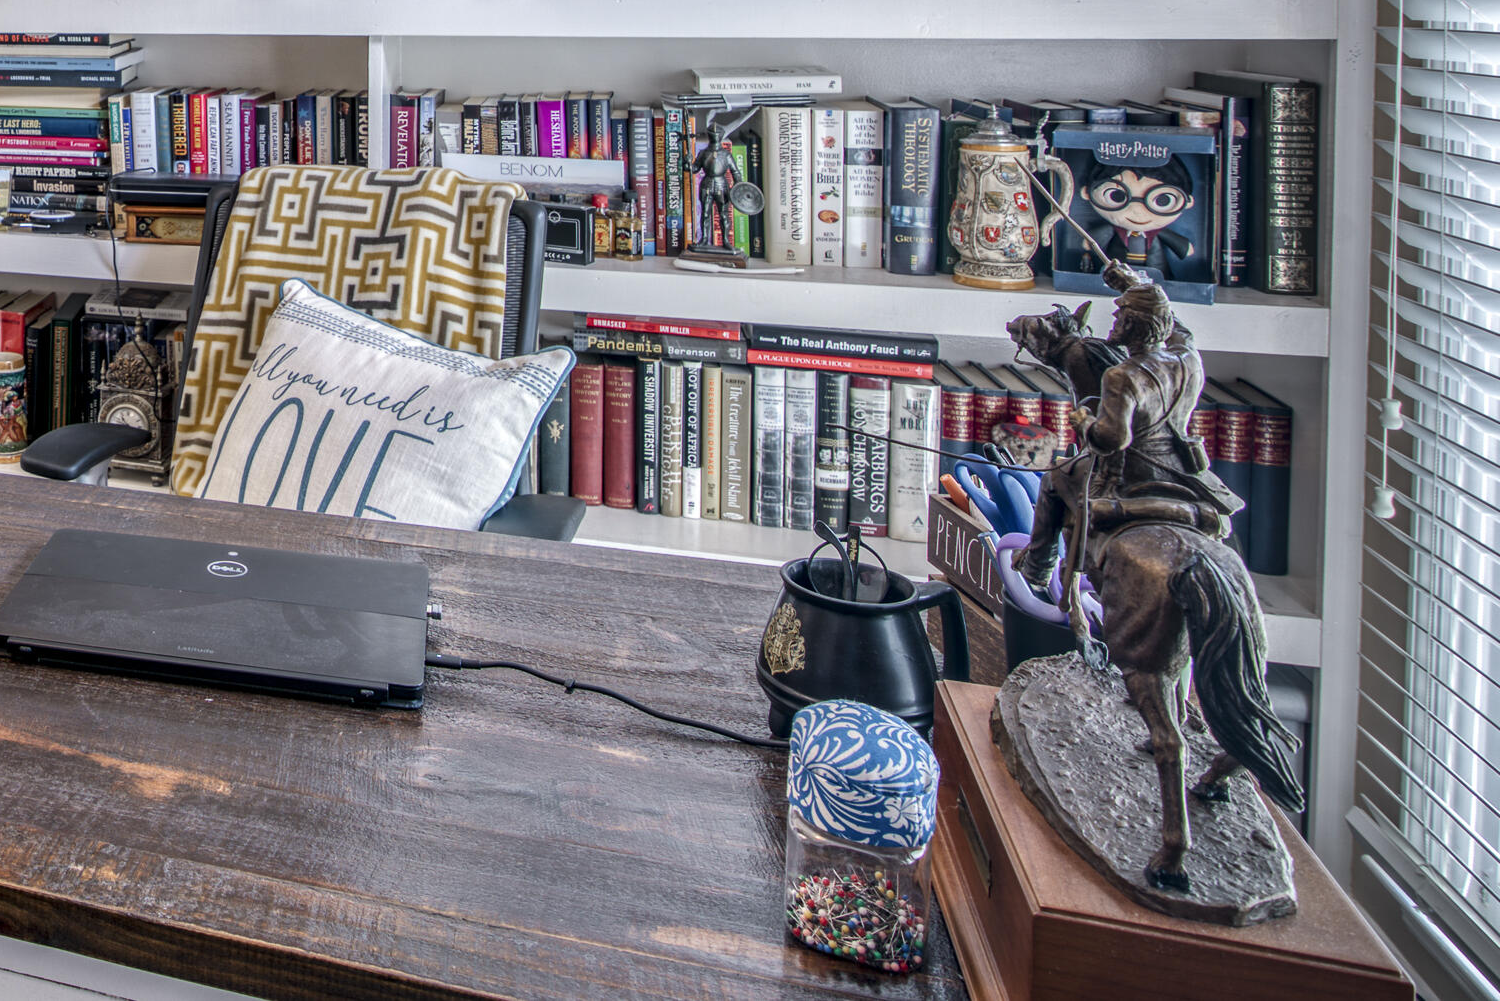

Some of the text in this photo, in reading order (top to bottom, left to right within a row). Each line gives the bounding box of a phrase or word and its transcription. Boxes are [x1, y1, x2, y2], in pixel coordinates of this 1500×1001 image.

[4, 119, 18, 128] LAST
[19, 119, 41, 129] HERO:
[173, 102, 187, 156] TRIGGERED
[358, 105, 368, 159] TRUMP
[1269, 125, 1315, 133] STRONG'S
[223, 102, 232, 168] SEAN HANNITY
[902, 121, 916, 193] THEOLOGY
[917, 117, 932, 197] SYSTEMATIC
[1097, 140, 1169, 159] Harry Potter
[15, 167, 76, 177] RIGHT PAPERS
[500, 162, 563, 178] BENOM
[790, 113, 803, 241] THE IVP BIBLE BACKGROUND
[816, 172, 842, 184] BIBLE
[33, 180, 75, 193] Invasion
[11, 195, 49, 206] NATION
[592, 319, 626, 330] UNMASKED
[587, 336, 716, 360] Pandemia Berenson
[780, 335, 899, 356] The Real Anthony Fauci
[341, 385, 422, 422] need
[424, 406, 464, 432] is
[644, 364, 654, 462] THE SHADOW UNIVERSITY
[670, 417, 681, 484] BIRTH
[726, 386, 742, 507] The Creature from Jekyll Island
[212, 565, 242, 573] DELL
[177, 645, 214, 654] Latitude
